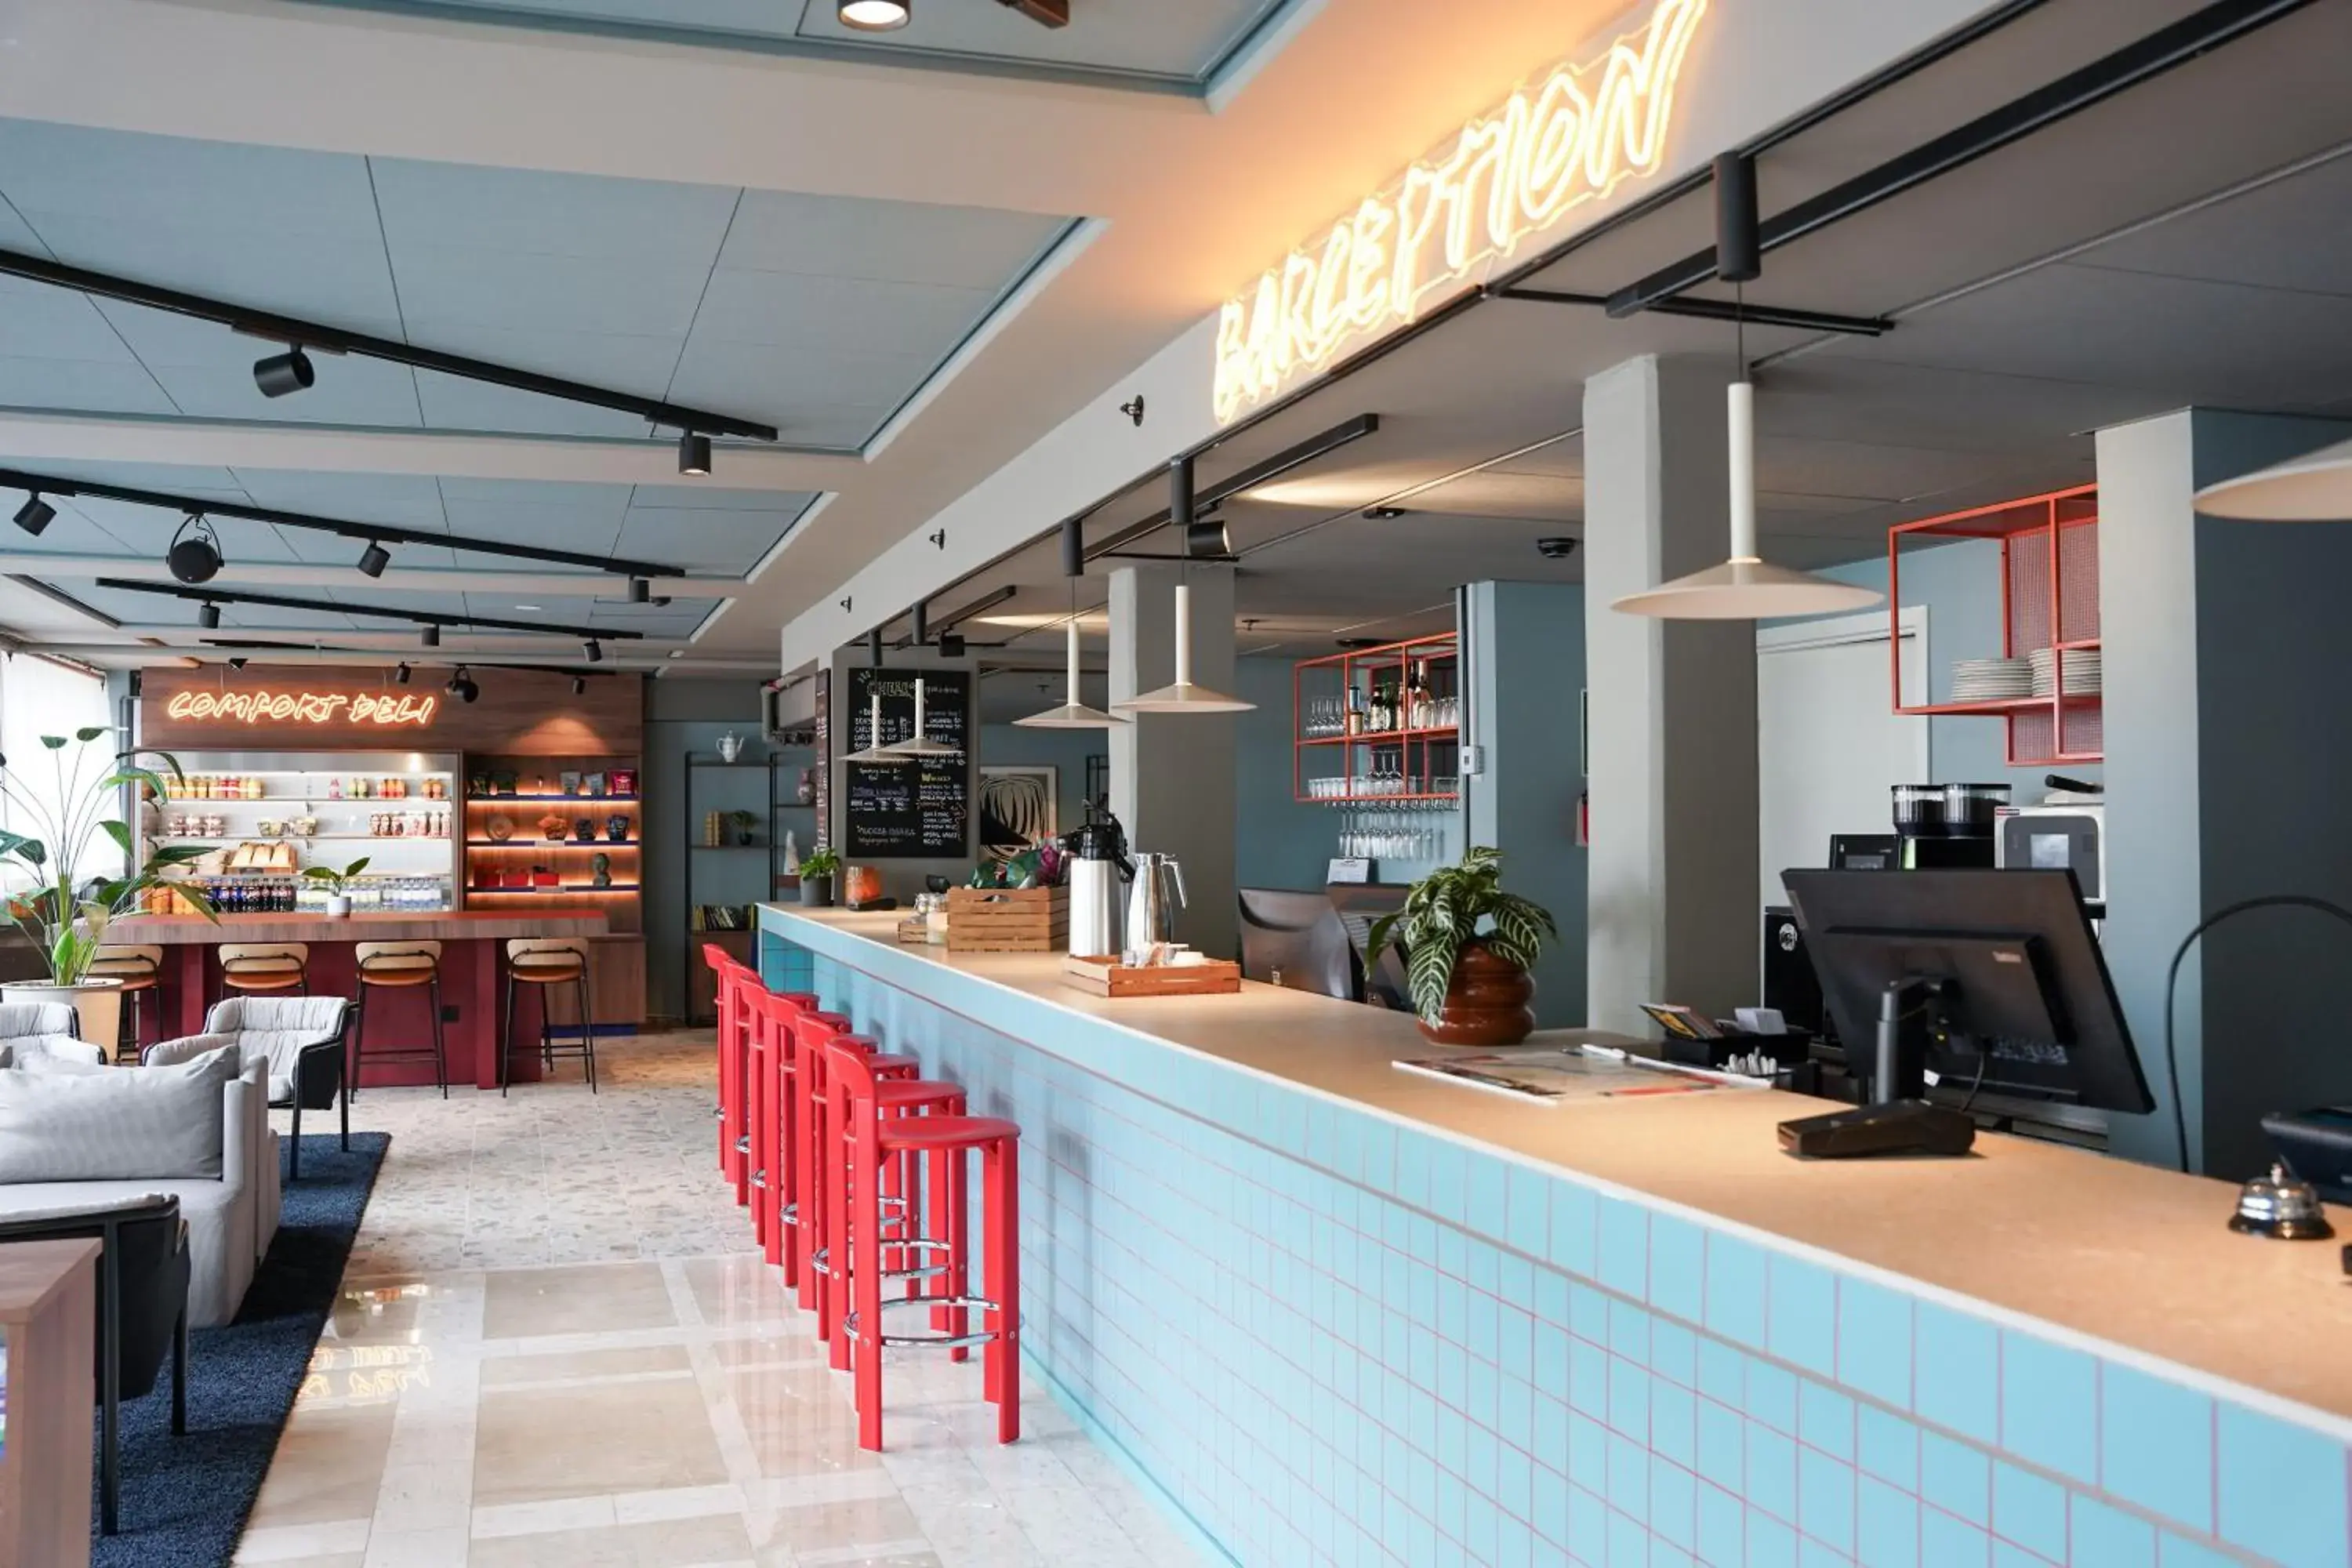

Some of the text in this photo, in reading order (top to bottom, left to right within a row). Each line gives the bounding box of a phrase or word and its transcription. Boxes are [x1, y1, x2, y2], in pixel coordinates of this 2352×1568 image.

[1214, 0, 1708, 424] BARCEPTION
[168, 691, 436, 724] COMFORT DELI
